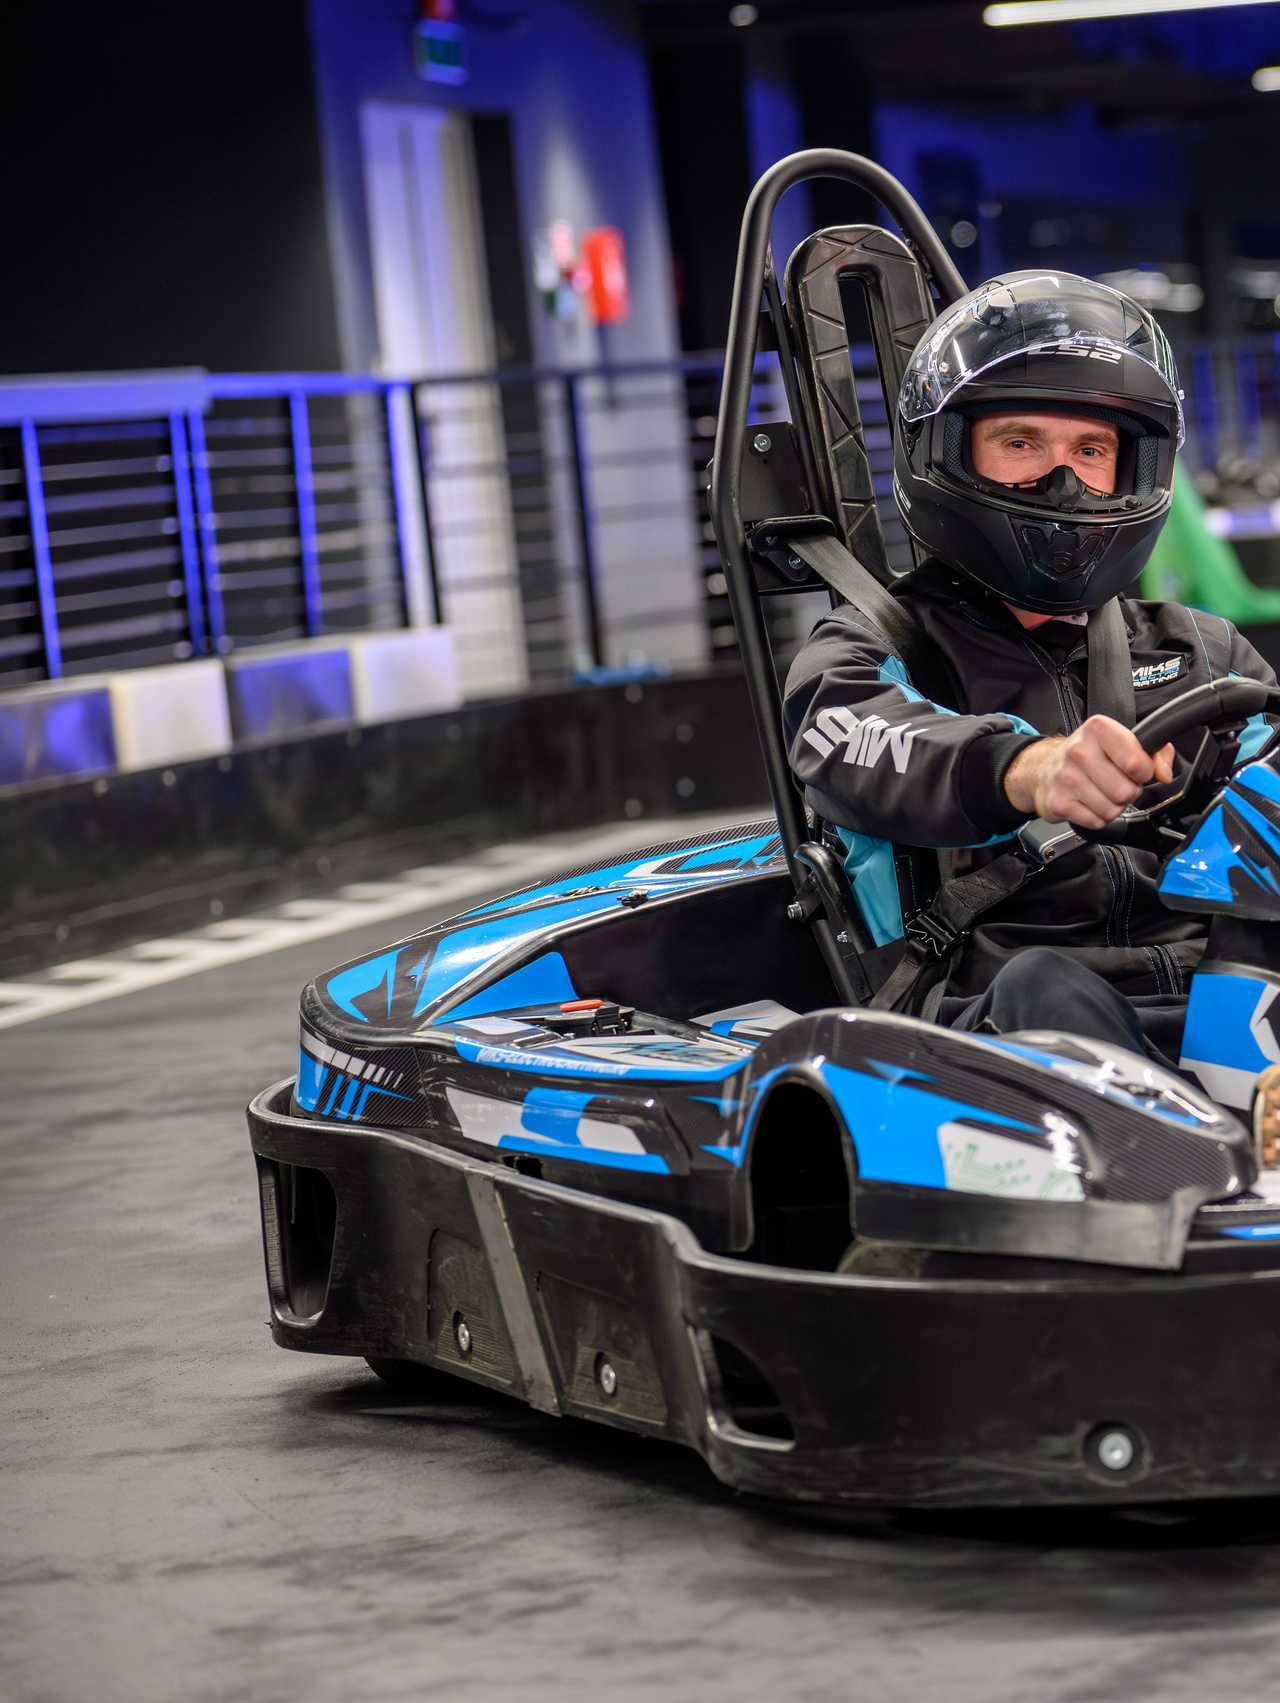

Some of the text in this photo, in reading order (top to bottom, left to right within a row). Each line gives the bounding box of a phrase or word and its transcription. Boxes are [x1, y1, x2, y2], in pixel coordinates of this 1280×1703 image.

[1027, 343, 1122, 365] LS2
[1132, 666, 1180, 682] LECTRO
[1133, 671, 1179, 687] ARTING
